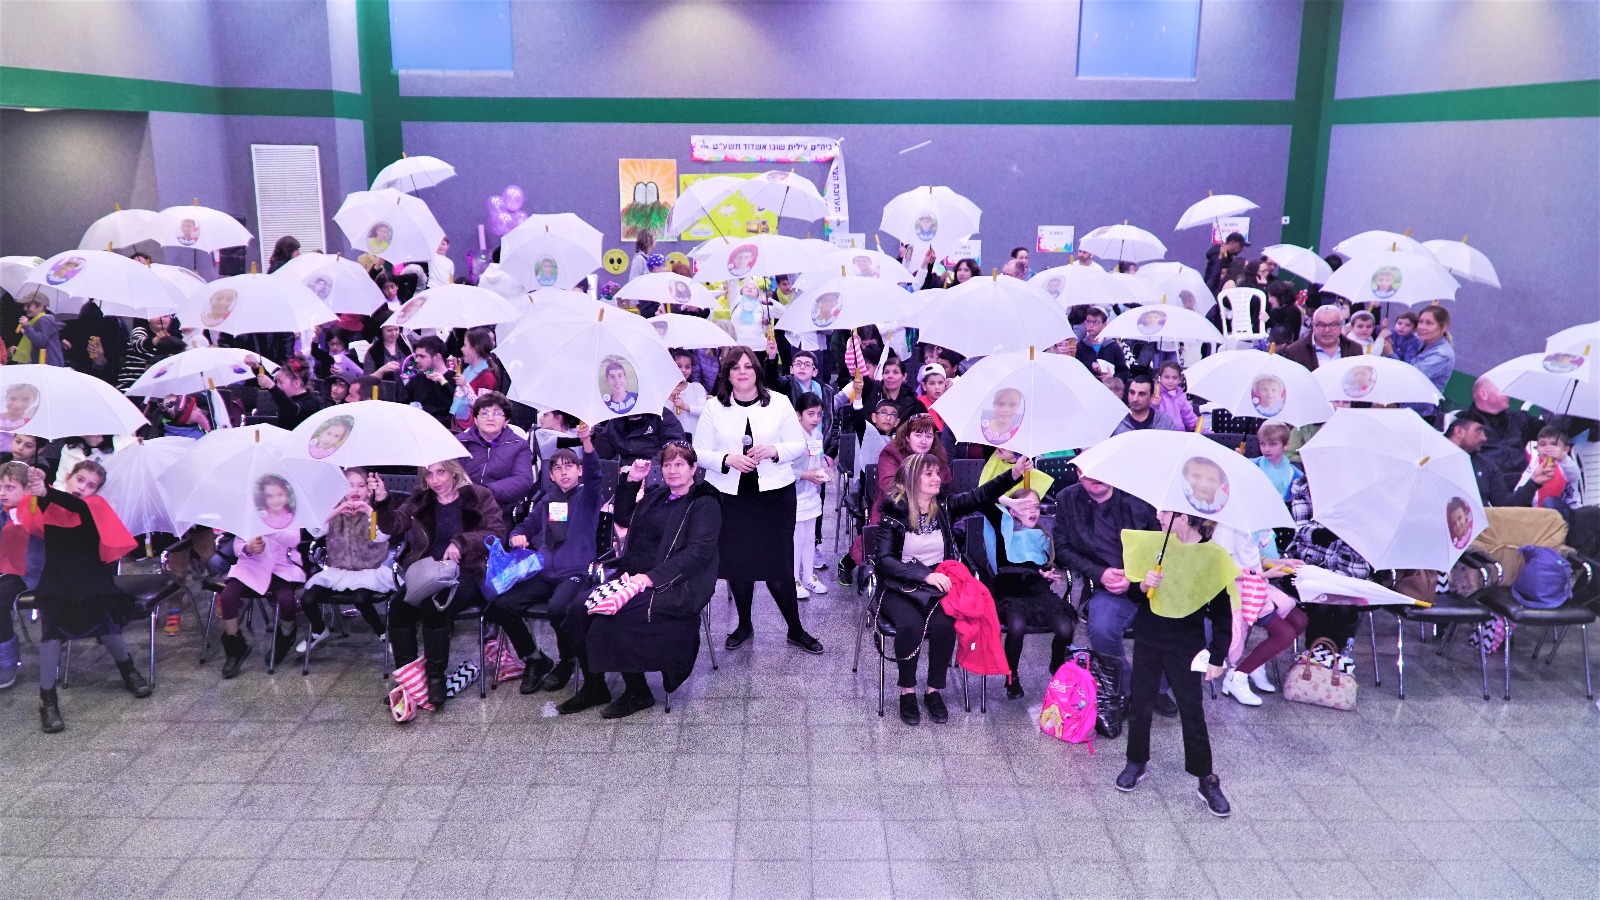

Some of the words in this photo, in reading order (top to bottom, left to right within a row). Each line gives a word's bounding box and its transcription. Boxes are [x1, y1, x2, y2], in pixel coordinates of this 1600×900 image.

[743, 143, 767, 151] אשדוד
[769, 143, 785, 151] שובו
[787, 141, 808, 151] עילית
